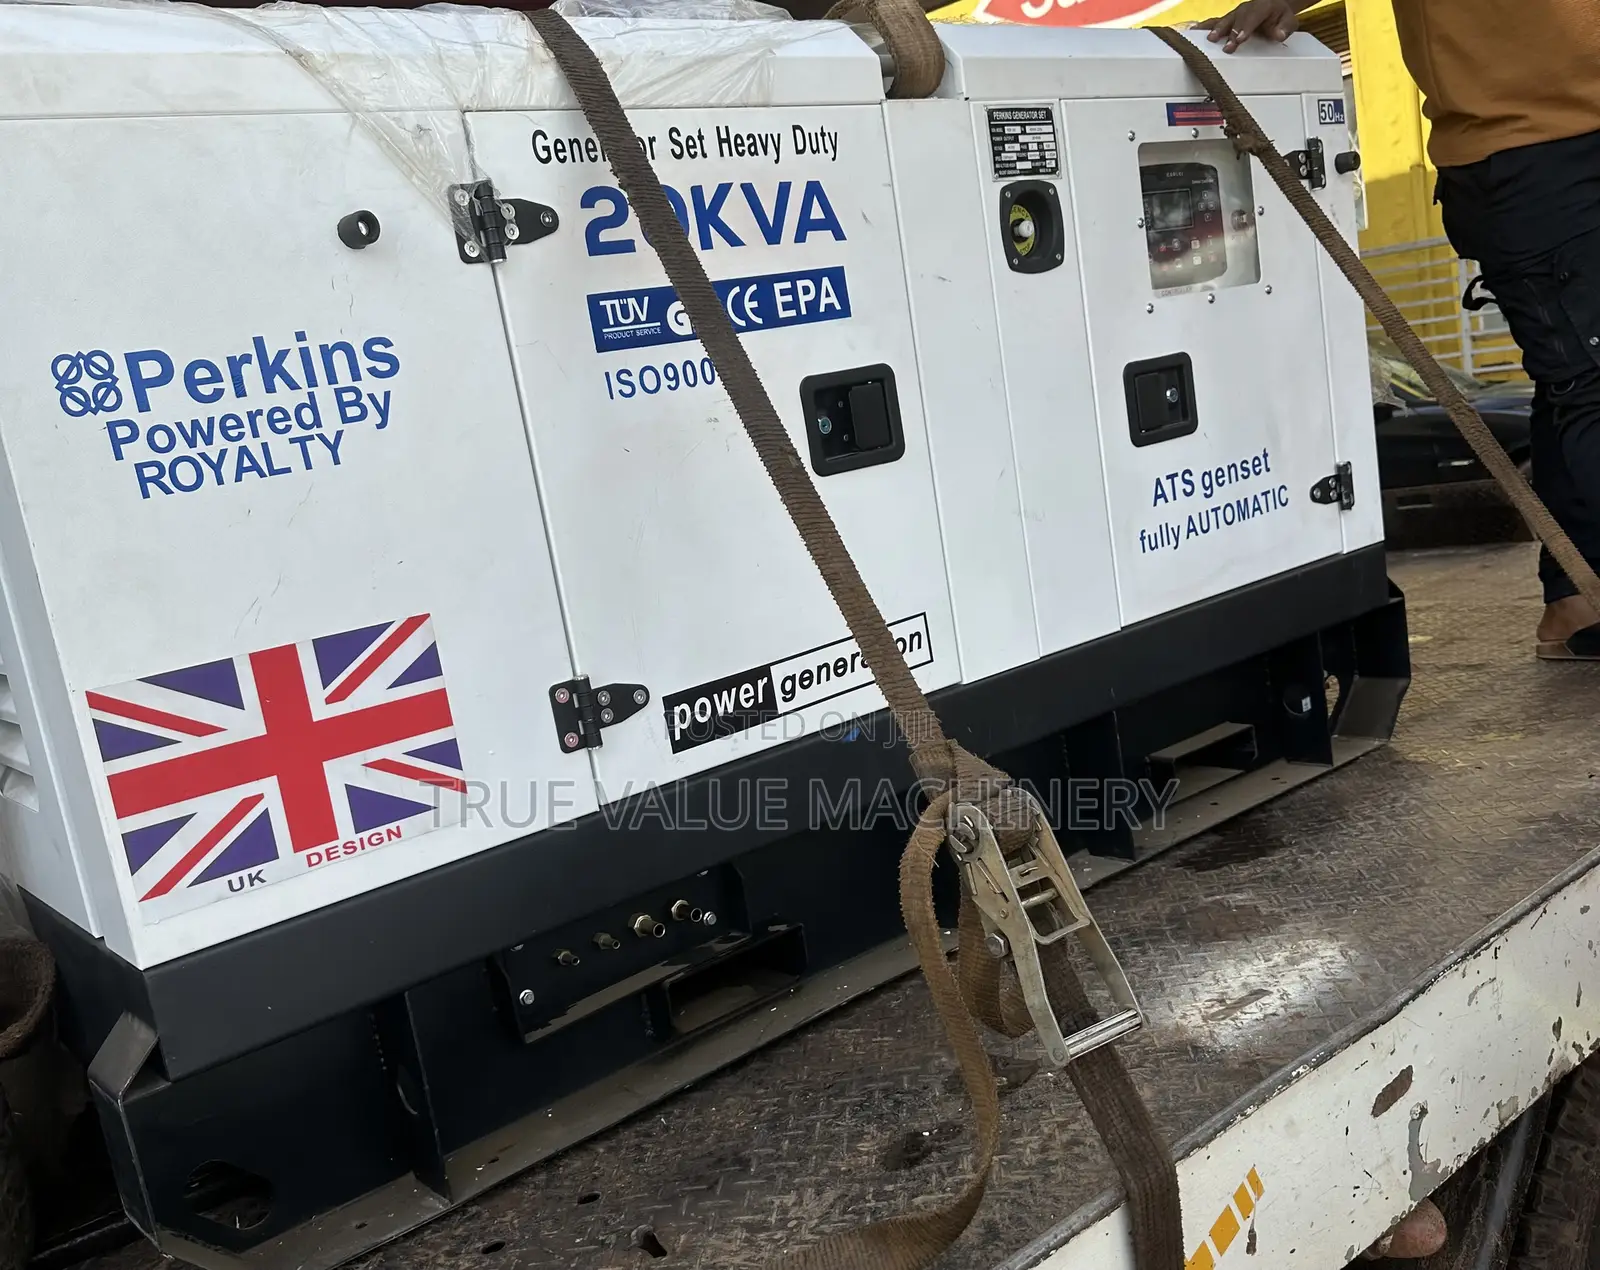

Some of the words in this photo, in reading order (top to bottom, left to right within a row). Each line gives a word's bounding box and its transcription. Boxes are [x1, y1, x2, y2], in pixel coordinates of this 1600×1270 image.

[532, 129, 656, 164] Gener
[668, 126, 708, 160] Set
[715, 125, 782, 164] Heavy
[792, 124, 838, 161] Duty
[993, 111, 1012, 120] PERKINS
[1012, 110, 1038, 120] GENERATOR
[1038, 110, 1047, 119] SET
[599, 296, 650, 326] TÜV
[773, 276, 842, 319] EPA
[603, 330, 634, 341] PRODUCT
[636, 327, 662, 338] SERVICE
[123, 330, 401, 413] Perkins
[604, 357, 716, 400] ISO900
[106, 391, 323, 461] Powered
[334, 385, 392, 430] By
[134, 429, 345, 500] ROYALTY
[1152, 468, 1196, 507] ATS
[1201, 447, 1271, 499] genset
[1139, 522, 1181, 554] fully
[1186, 484, 1289, 540] AUTOMATIC
[672, 675, 769, 741] power
[780, 630, 923, 703] generon
[227, 869, 267, 893] UK
[305, 825, 403, 868] DESIGN
